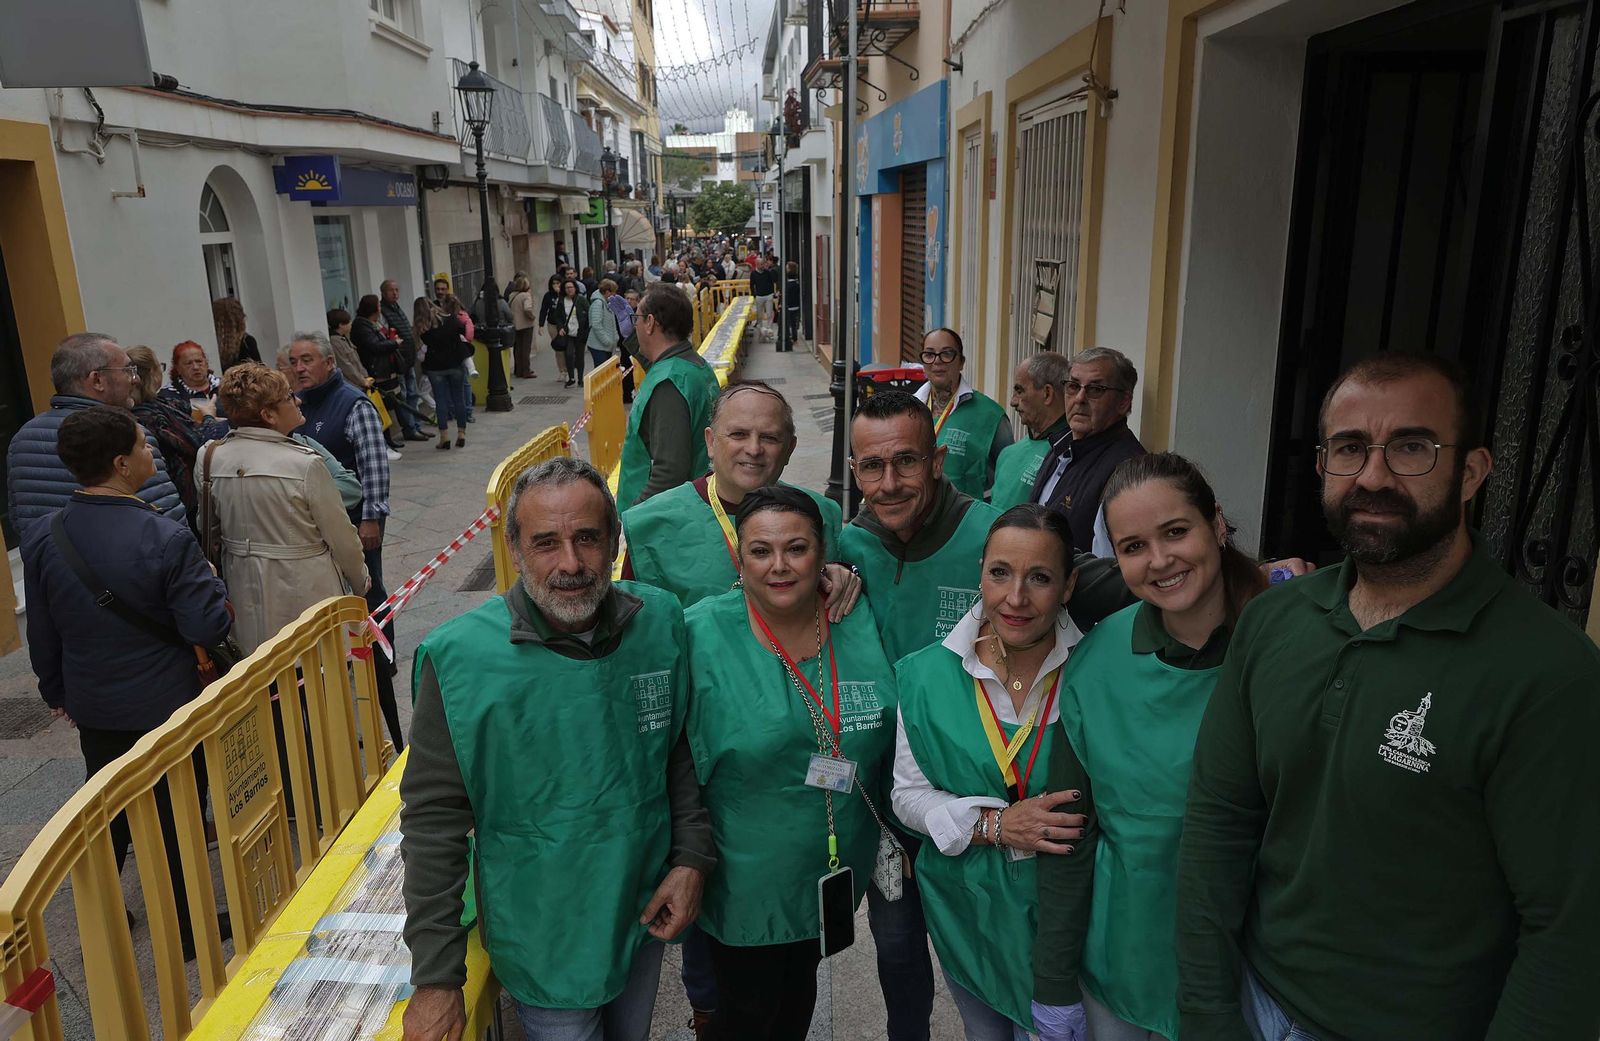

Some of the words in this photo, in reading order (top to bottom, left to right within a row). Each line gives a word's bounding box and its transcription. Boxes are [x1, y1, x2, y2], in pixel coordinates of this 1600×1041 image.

[395, 182, 415, 197] OCASO
[856, 720, 883, 731] Barrios
[1388, 751, 1429, 772] TAGARNINA
[229, 761, 266, 803] Ayuntamiento
[229, 800, 244, 819] Los
[244, 774, 269, 804] Barrios
